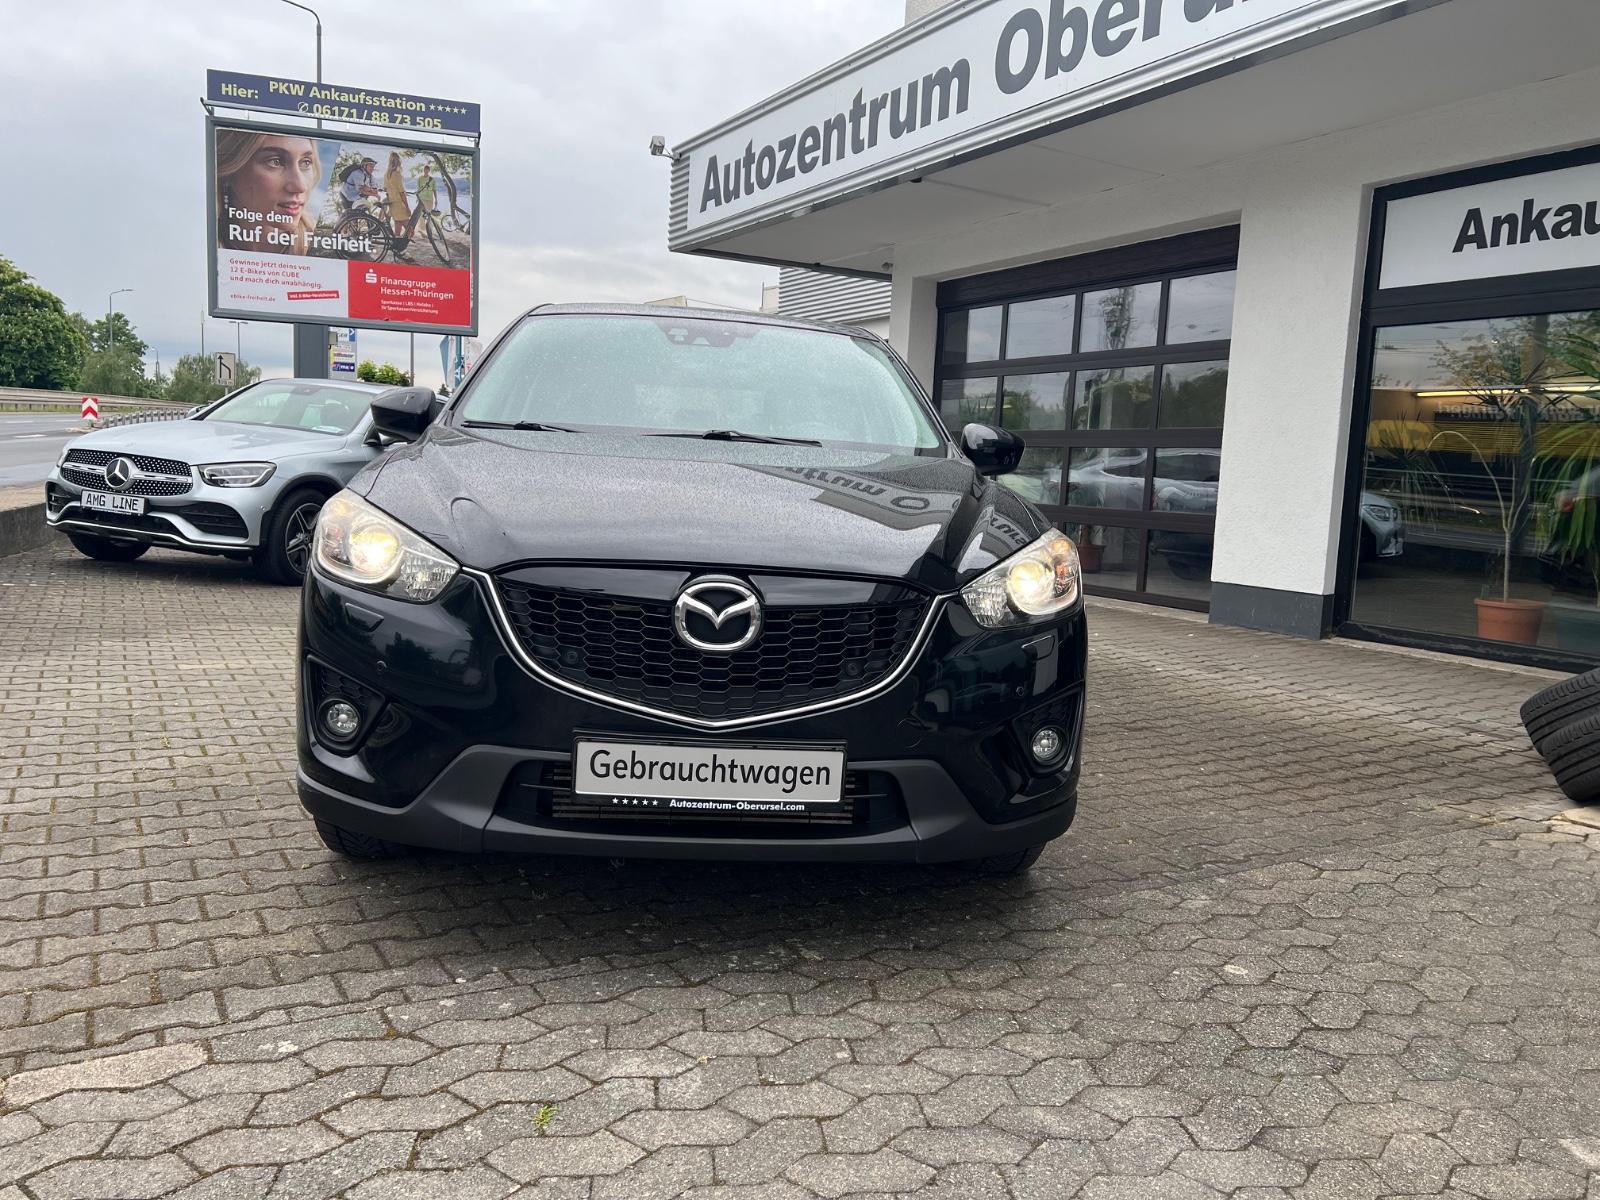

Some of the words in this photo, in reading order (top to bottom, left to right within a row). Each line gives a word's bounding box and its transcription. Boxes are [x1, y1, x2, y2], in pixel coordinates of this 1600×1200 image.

[221, 83, 259, 99] Hier:
[269, 81, 304, 96] PKW
[309, 87, 426, 112] Ankaufsstation
[312, 103, 358, 119] 06171
[371, 111, 390, 124] 88
[394, 114, 411, 125] 73
[416, 116, 442, 129] 505
[699, 58, 970, 212] Autozentrum
[229, 208, 262, 221] Folge
[267, 211, 293, 223] dem
[229, 224, 263, 242] Ruf
[267, 228, 297, 246] der
[304, 232, 377, 253] Freiheit.
[229, 258, 259, 267] Gewinne
[260, 261, 277, 269] jetzt
[240, 268, 266, 276] E-Bikes
[281, 271, 300, 279] CUBE
[265, 278, 280, 286] dich
[380, 276, 436, 288] Finanzgruppe
[380, 288, 454, 300] Hessen-Thüringen
[86, 493, 105, 507] AMG
[112, 496, 138, 511] LINE
[590, 750, 830, 793] Gebrauchtwagen
[669, 799, 805, 811] Autozentrum-Oberursel.com
